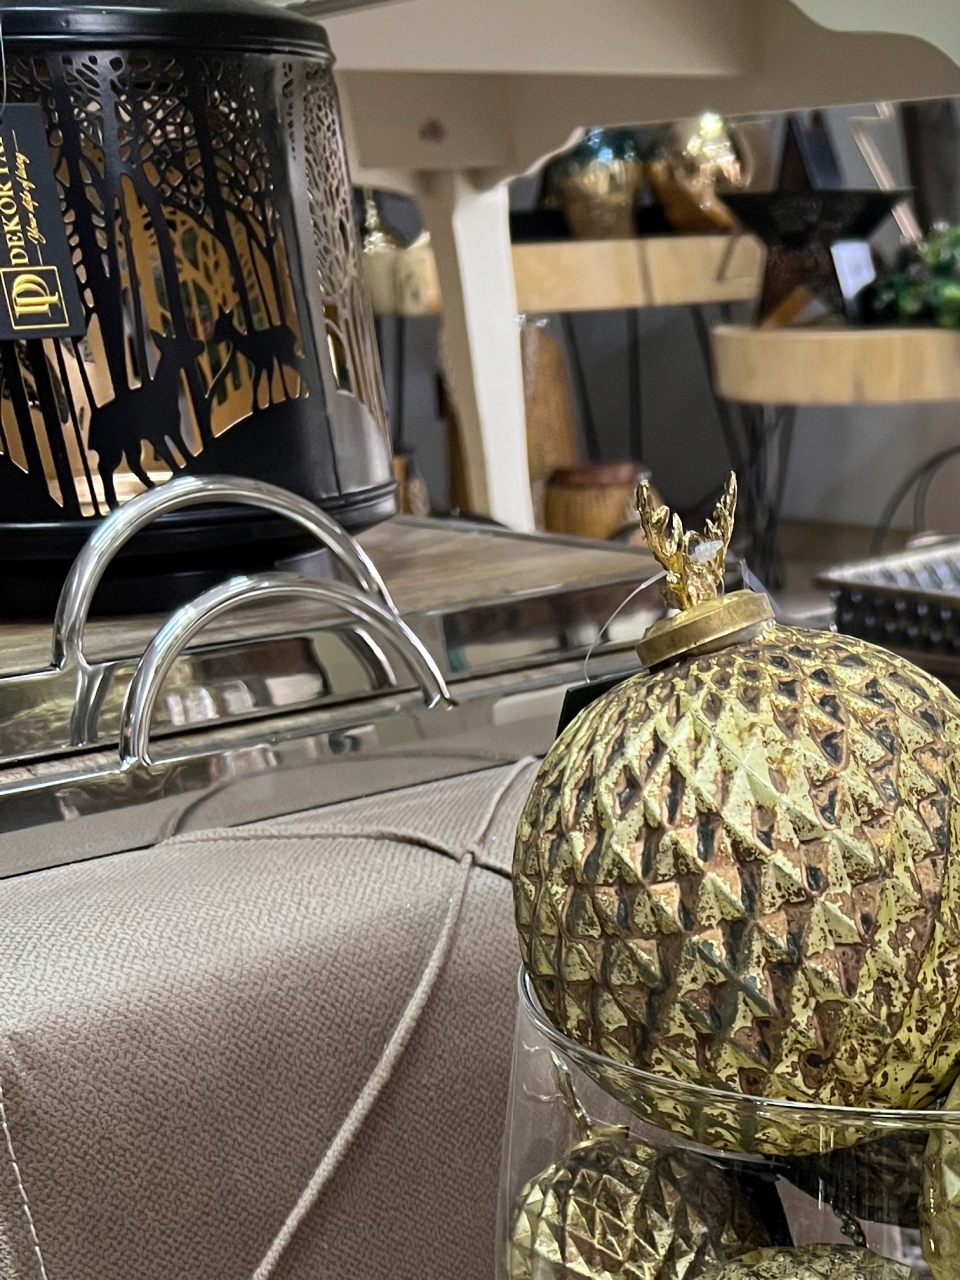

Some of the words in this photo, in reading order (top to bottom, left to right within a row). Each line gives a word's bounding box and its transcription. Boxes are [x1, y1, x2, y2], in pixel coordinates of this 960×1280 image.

[16, 176, 36, 190] of
[0, 181, 29, 265] DEKOR
[25, 213, 46, 244] Your
